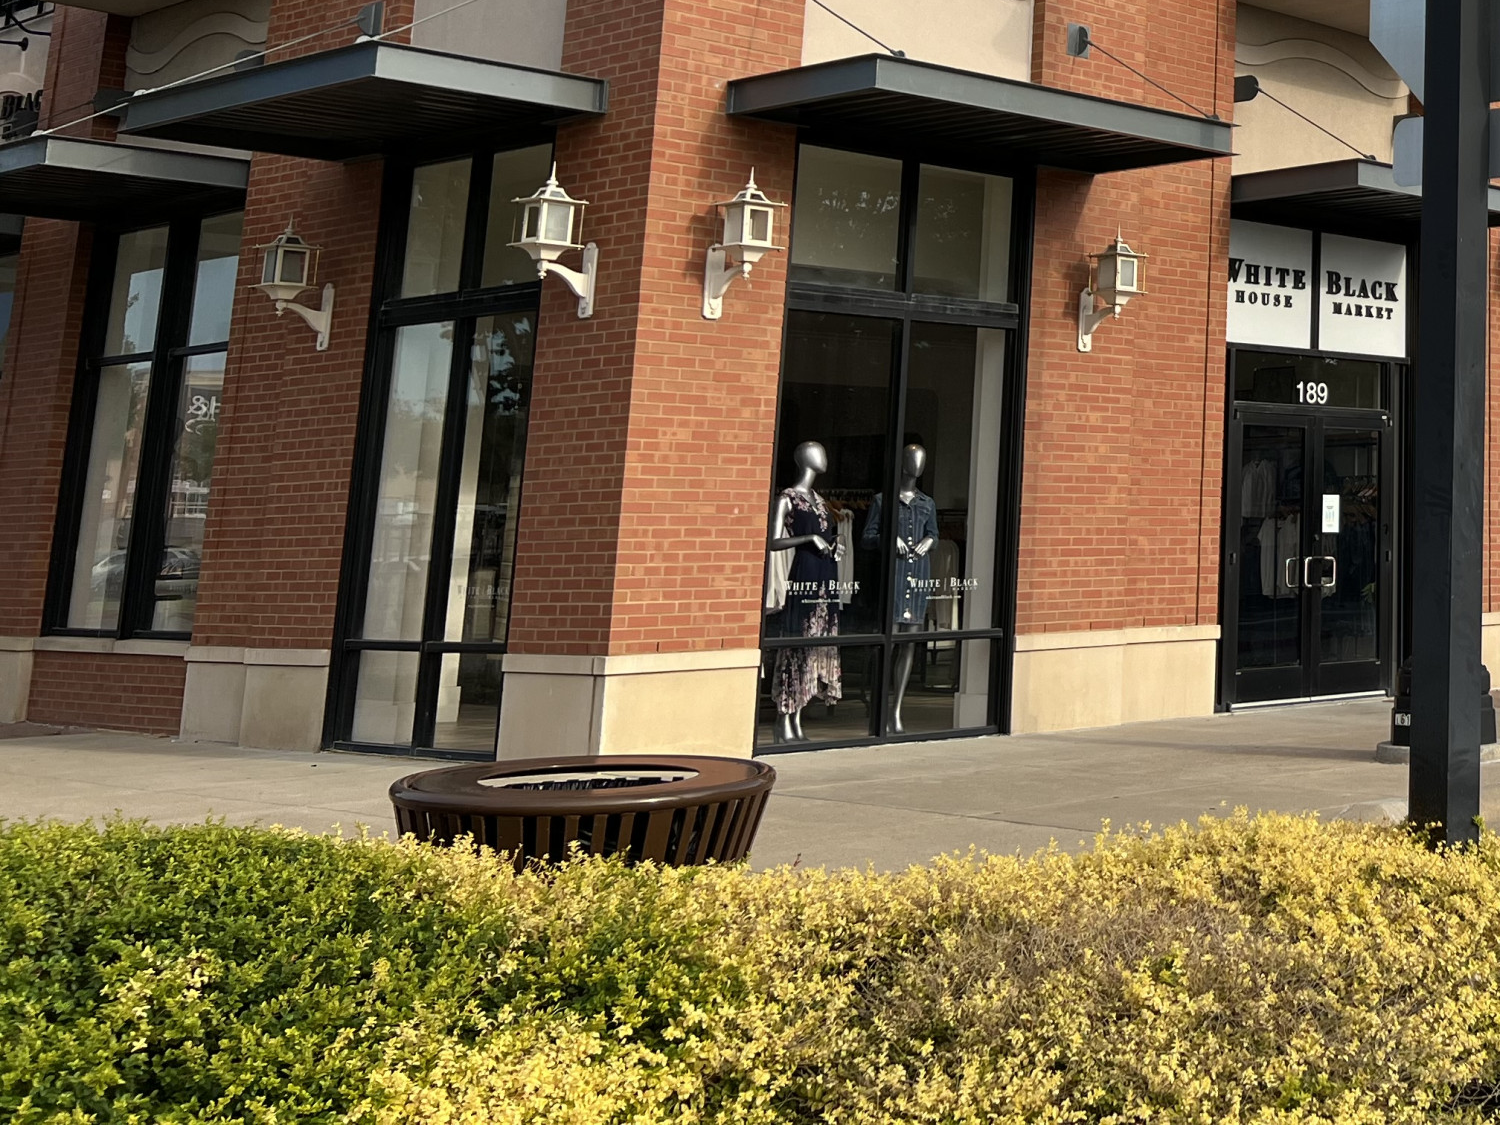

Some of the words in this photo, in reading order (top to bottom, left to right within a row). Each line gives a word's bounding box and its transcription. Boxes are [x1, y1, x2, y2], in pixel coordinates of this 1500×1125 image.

[1228, 257, 1307, 290] WHITE
[1325, 270, 1399, 303] BLACK
[1234, 289, 1293, 308] HOUSE
[1332, 301, 1394, 320] MARKET
[1296, 380, 1329, 405] 189
[784, 580, 818, 591] WHITE
[828, 579, 861, 591] BLACK
[910, 578, 940, 588] WHITE
[950, 577, 979, 587] BLACK
